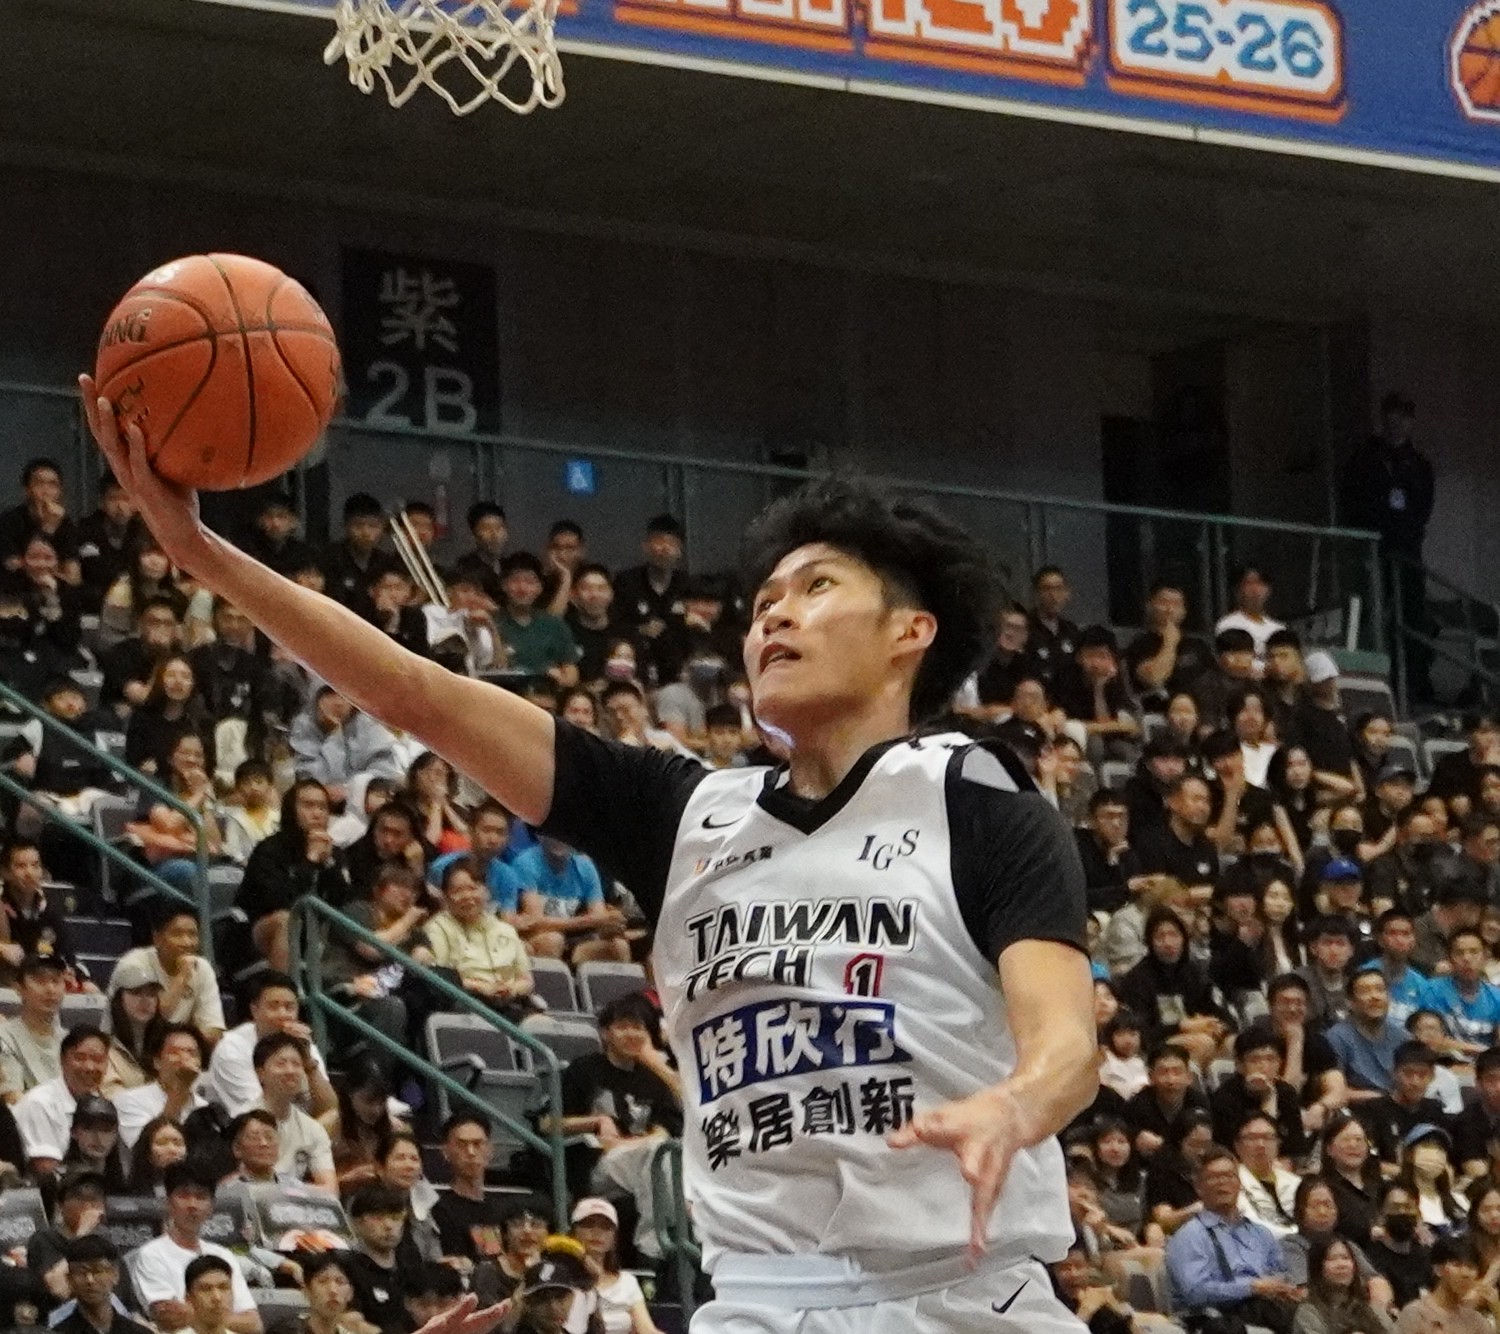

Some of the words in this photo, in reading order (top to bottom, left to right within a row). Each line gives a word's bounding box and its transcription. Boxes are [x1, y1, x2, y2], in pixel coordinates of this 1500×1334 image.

[379, 267, 461, 352] 紫
[366, 362, 479, 435] 2B
[855, 828, 921, 872] IGS
[686, 898, 918, 965] TAIWAN
[684, 946, 815, 1001] TECH
[699, 1001, 896, 1098] 特欣行
